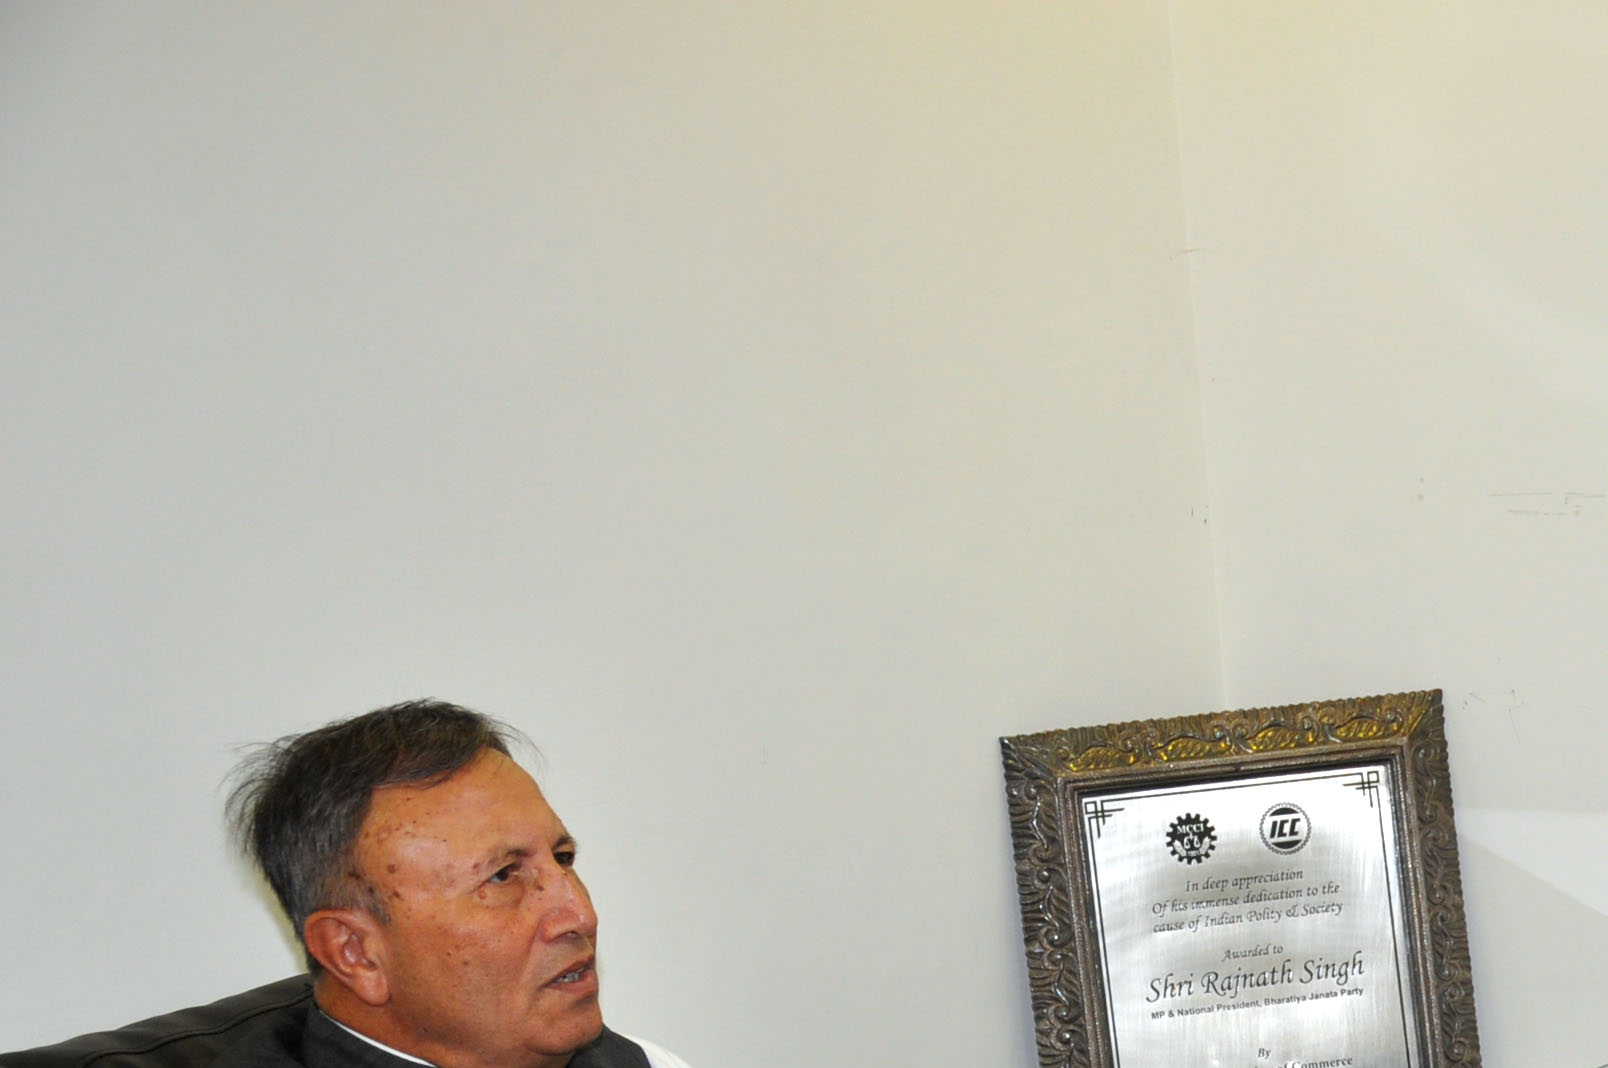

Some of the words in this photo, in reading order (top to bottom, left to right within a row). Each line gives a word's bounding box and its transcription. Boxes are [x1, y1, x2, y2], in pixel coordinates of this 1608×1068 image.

[1177, 822, 1205, 835] MCCI
[1270, 818, 1300, 839] ICC
[1186, 881, 1198, 892] In
[1203, 877, 1228, 892] deep
[1232, 870, 1303, 889] appreciation
[1152, 901, 1169, 918] Of
[1172, 898, 1187, 912] his
[1192, 895, 1239, 910] immense
[1244, 888, 1302, 905] dedication
[1307, 886, 1318, 895] to
[1323, 882, 1339, 894] the
[1153, 919, 1185, 933] cause
[1188, 915, 1201, 932] of
[1205, 913, 1243, 927] Indian
[1247, 907, 1281, 924] Polity
[1287, 904, 1300, 918] &
[1302, 902, 1343, 917] Society
[1222, 943, 1271, 961] Awarded
[1273, 943, 1283, 954] to
[1146, 973, 1194, 1003] Shri
[1201, 959, 1293, 998] Rajnath
[1300, 950, 1365, 985] Singh
[1151, 1011, 1165, 1019] MP
[1177, 1005, 1214, 1016] National
[1217, 1000, 1261, 1013] President,
[1264, 994, 1307, 1007] Bharatiya
[1309, 990, 1338, 1000] Janata
[1341, 987, 1364, 998] Party
[1258, 1048, 1271, 1059] By
